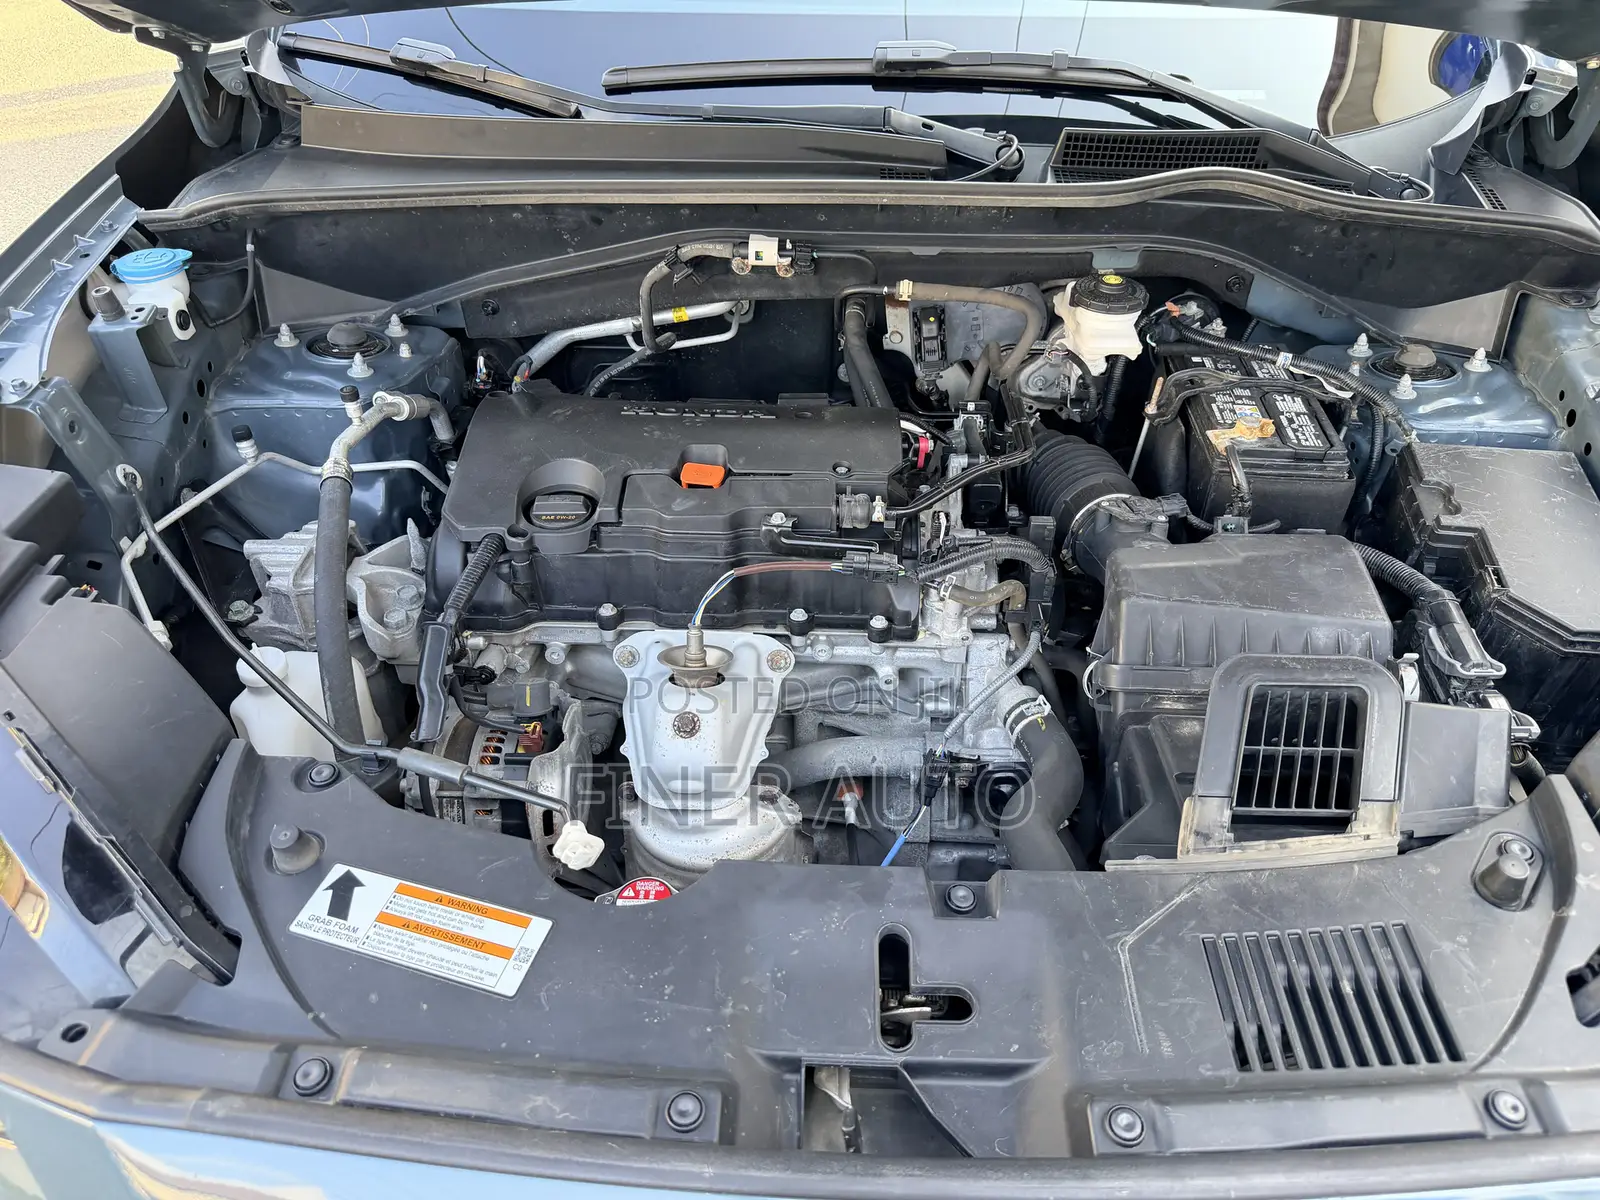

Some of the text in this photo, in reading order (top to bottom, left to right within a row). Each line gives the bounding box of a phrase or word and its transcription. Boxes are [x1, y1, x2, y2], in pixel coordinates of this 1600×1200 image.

[447, 897, 488, 915] WARNING
[295, 919, 359, 944] SAISIR LE PROTECTEUR
[308, 914, 359, 934] GRAB FOAM
[411, 923, 486, 950] AVERTISSEMENT
